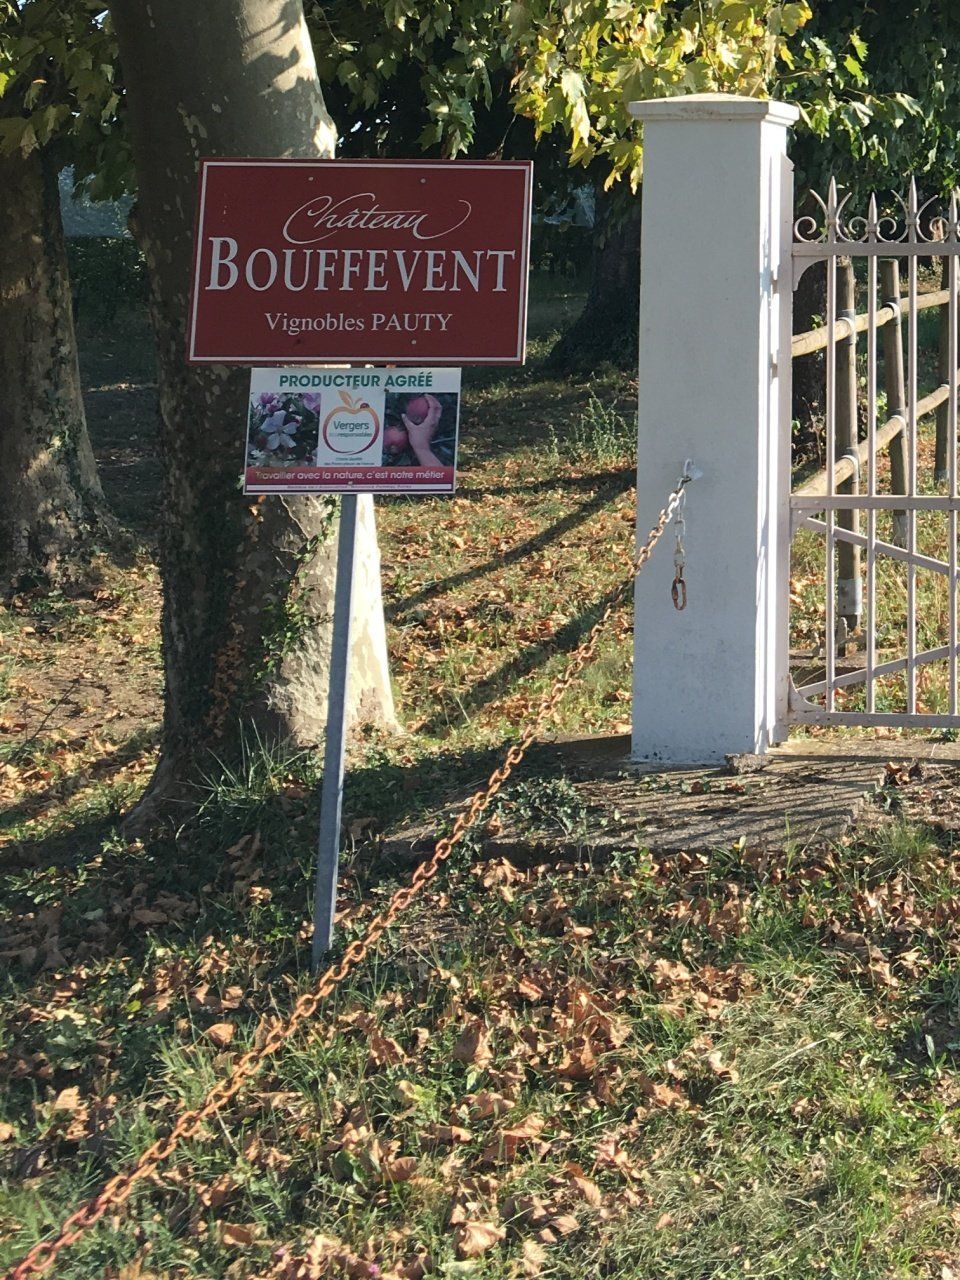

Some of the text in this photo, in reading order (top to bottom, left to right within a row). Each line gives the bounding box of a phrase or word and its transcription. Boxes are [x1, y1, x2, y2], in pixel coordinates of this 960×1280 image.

[282, 192, 472, 245] Château
[204, 236, 516, 292] BOUFFEVENT
[264, 312, 453, 336] Vignobles PAUTY
[279, 371, 433, 388] PRODUCTEUR AGRÉÉ
[333, 420, 370, 432] Vergers
[255, 471, 295, 480] Travailler
[322, 471, 331, 480] la
[333, 472, 364, 481] nature,
[366, 471, 388, 480] c'est
[390, 471, 413, 480] notre
[415, 470, 445, 480] métier
